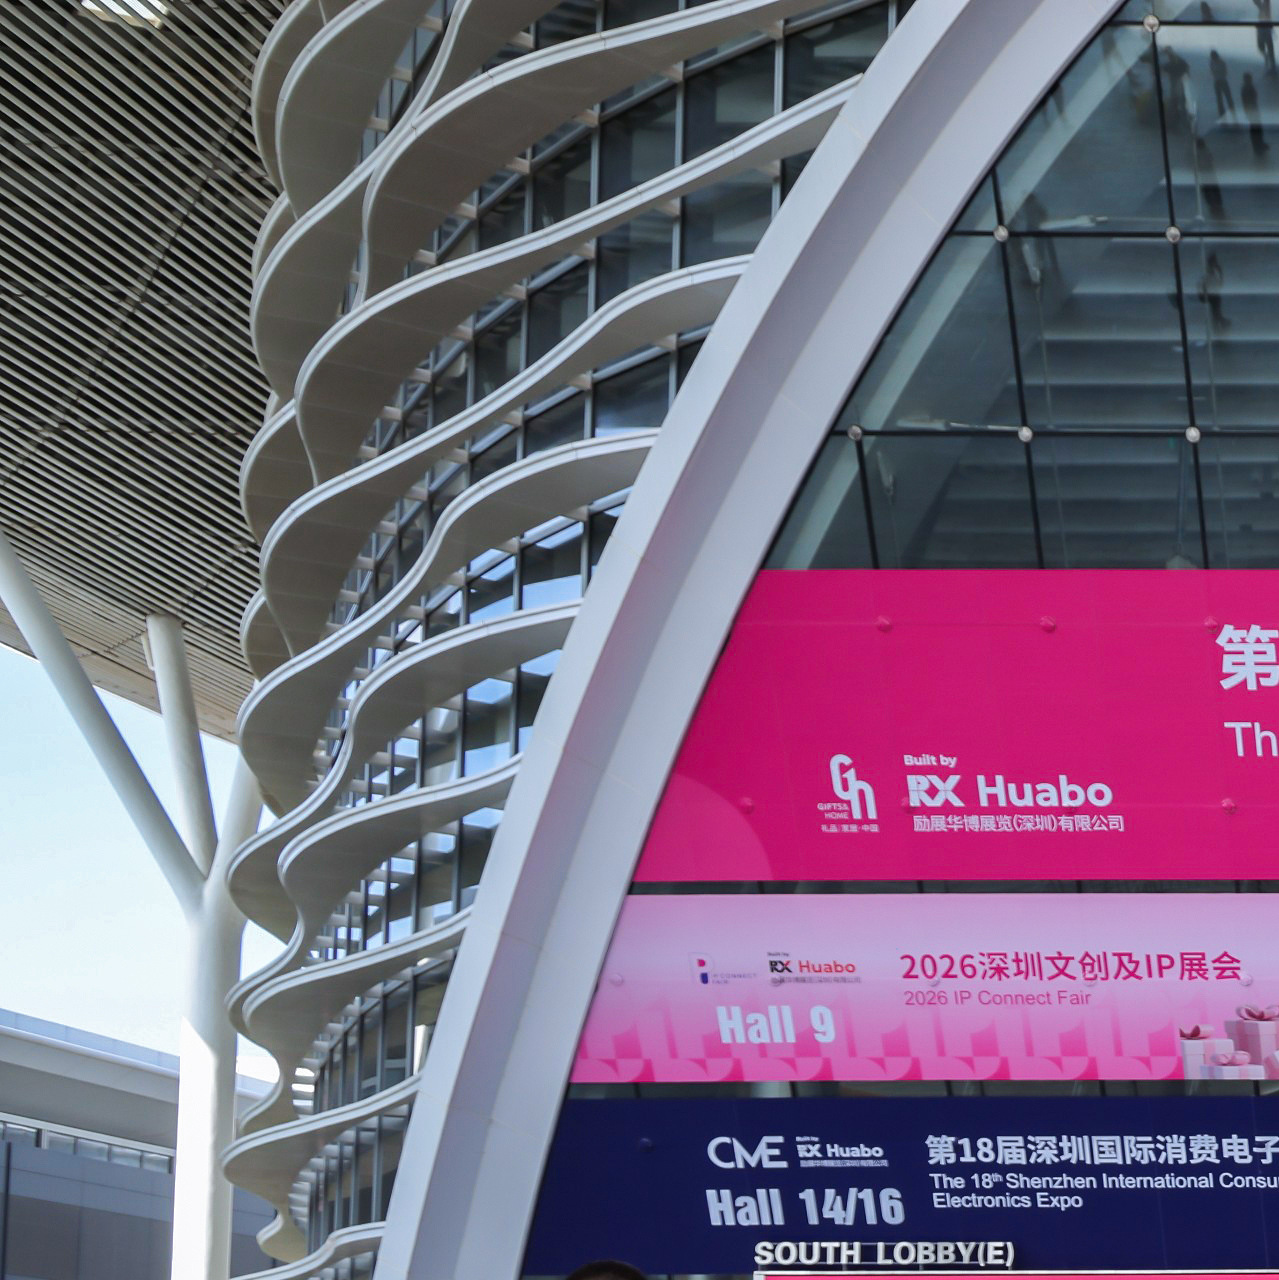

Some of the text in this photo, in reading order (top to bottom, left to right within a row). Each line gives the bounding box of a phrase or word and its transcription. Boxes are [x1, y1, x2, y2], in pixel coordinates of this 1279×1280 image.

[904, 754, 957, 768] Built by
[906, 775, 1113, 807] RX Huabo
[769, 960, 856, 973] RX Huabo
[900, 950, 1242, 982] 2026深圳文创及IP展会
[904, 990, 1091, 1006] 2026 IP Connect Fair
[717, 1005, 836, 1044] Hall 9
[707, 1136, 788, 1168] CME
[826, 1144, 884, 1157] Huabo
[930, 1173, 966, 1189] The
[971, 1173, 1003, 1189] 18th
[1006, 1173, 1097, 1189] Shenzhen
[1102, 1173, 1214, 1189] International
[706, 1188, 905, 1226] Hall 14/16
[932, 1192, 1083, 1211] Electronics Expo
[754, 1241, 1014, 1267] SOUTH LOBBY(E)
